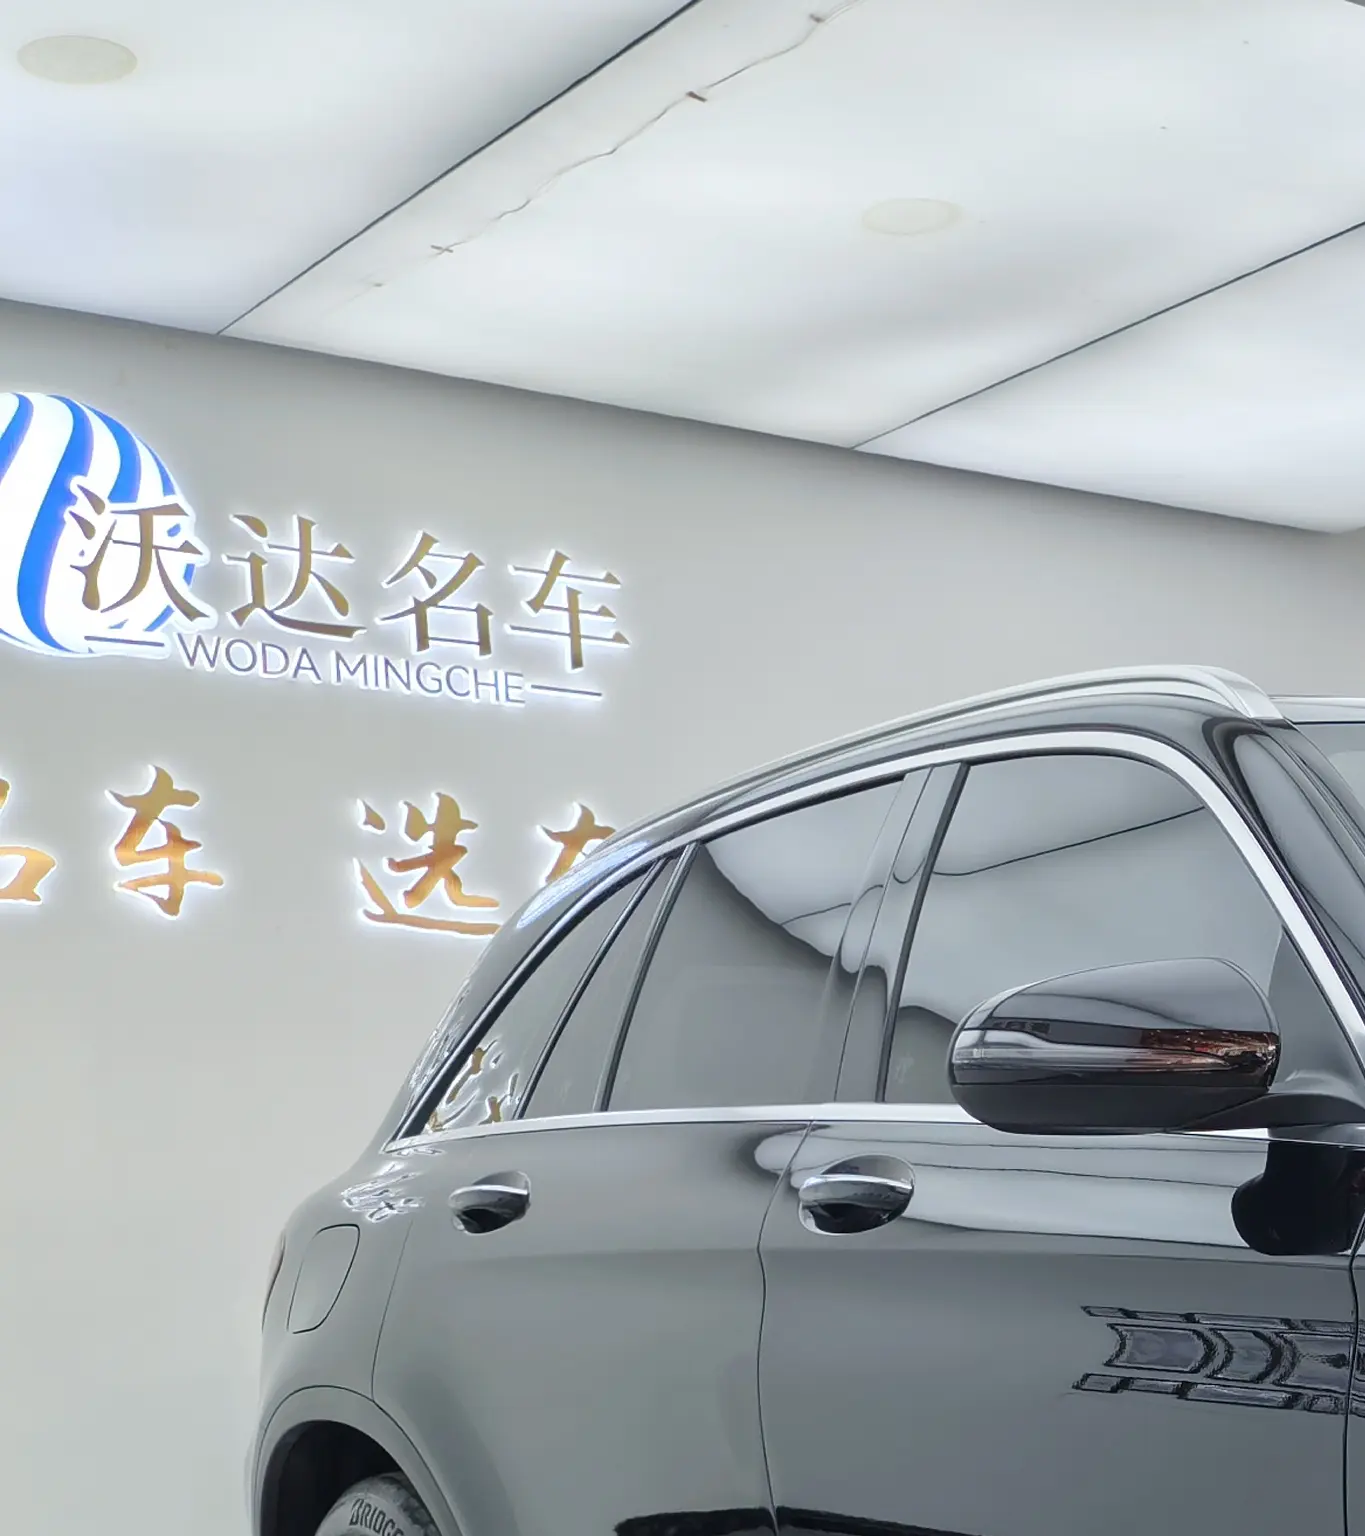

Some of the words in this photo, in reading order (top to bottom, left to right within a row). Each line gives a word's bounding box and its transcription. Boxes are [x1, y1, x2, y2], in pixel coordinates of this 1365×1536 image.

[71, 485, 630, 670] 沃达名车
[181, 633, 322, 683] WODA
[331, 655, 526, 706] MINGCHE
